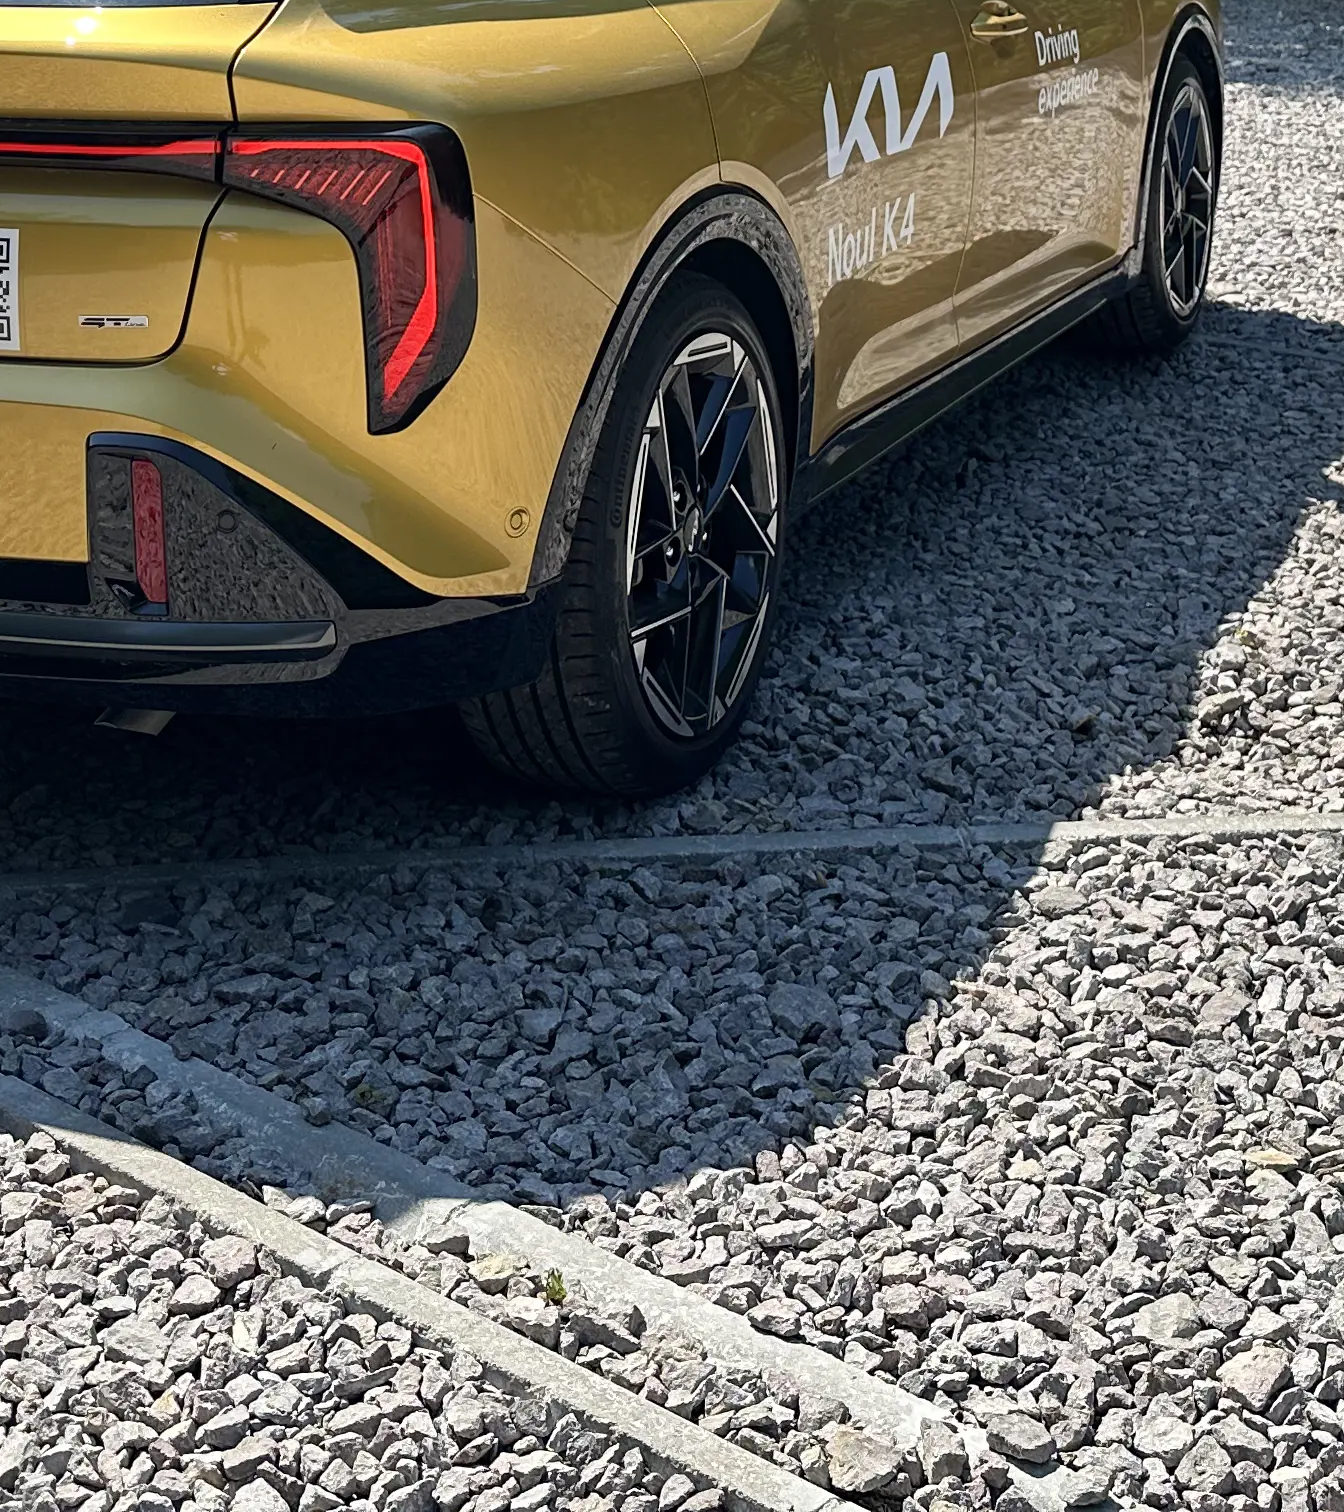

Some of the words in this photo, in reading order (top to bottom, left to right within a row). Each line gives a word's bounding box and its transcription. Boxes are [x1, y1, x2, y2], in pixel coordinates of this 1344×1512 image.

[1035, 24, 1080, 66] Driving
[823, 51, 954, 179] KIA
[1038, 68, 1099, 118] experience
[828, 206, 877, 286] Noul
[882, 192, 916, 257] K4
